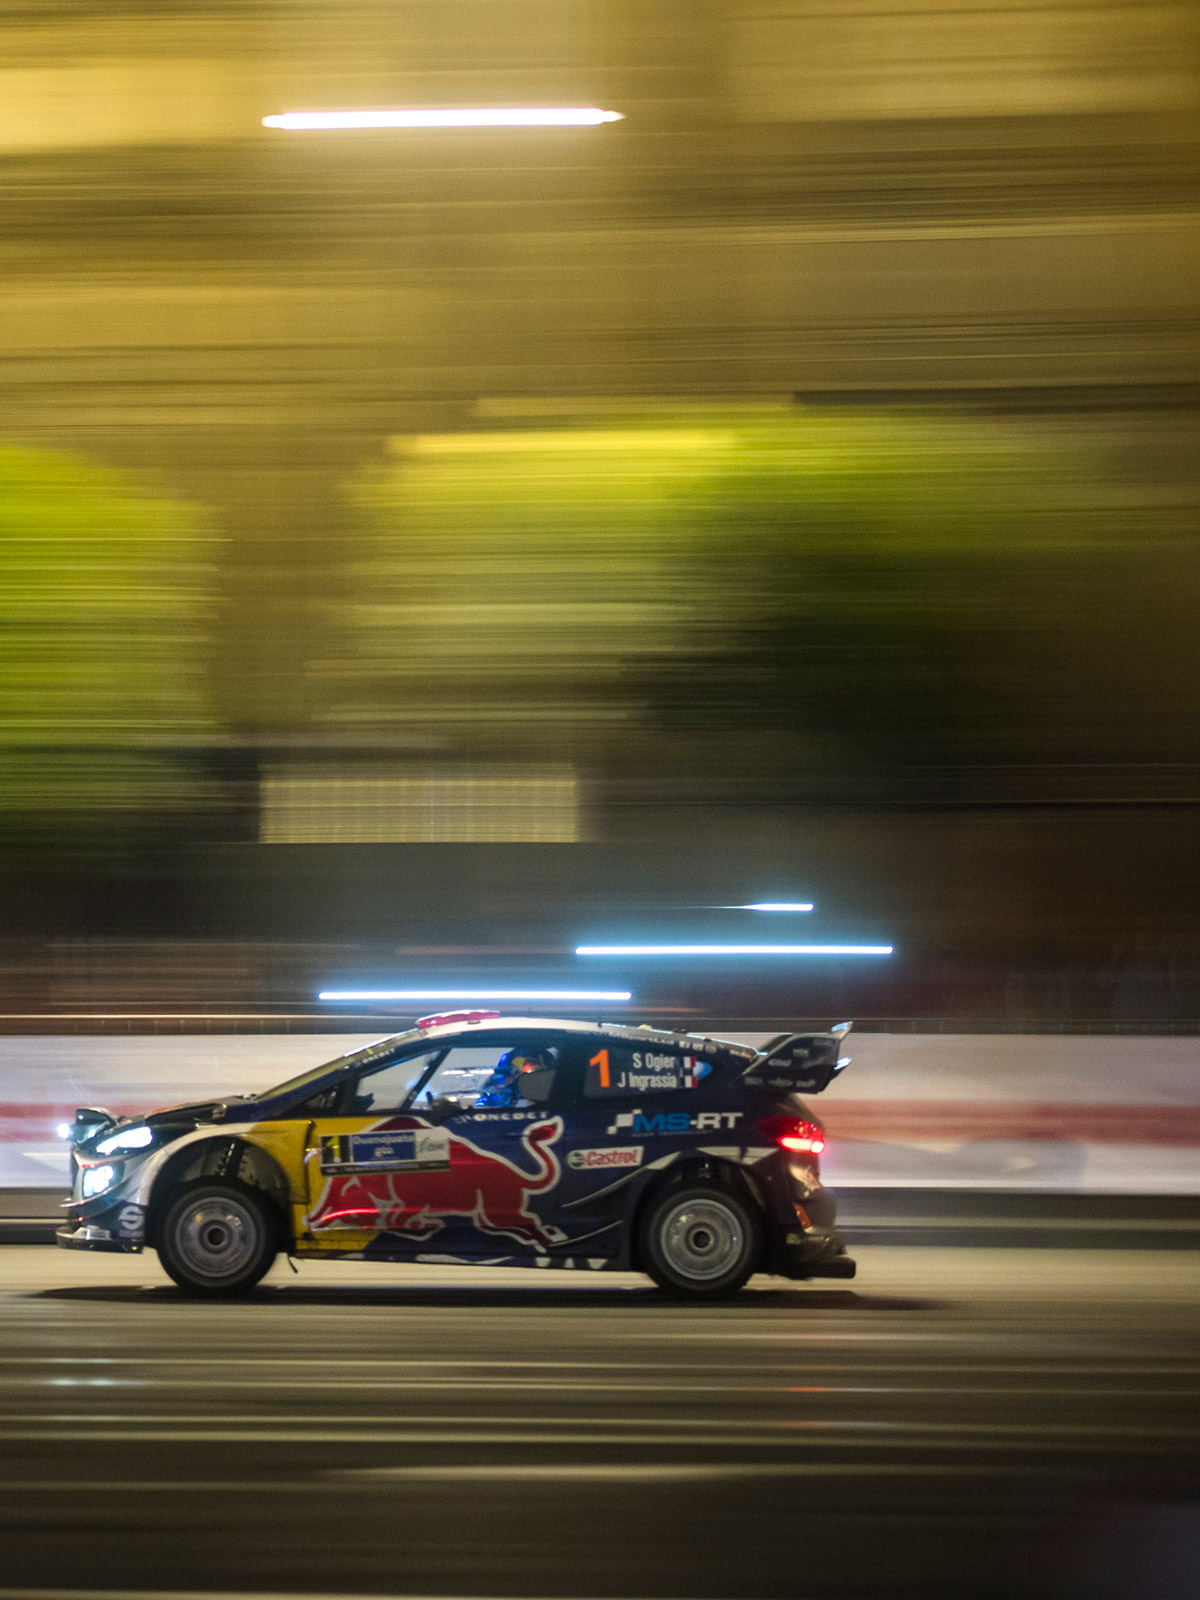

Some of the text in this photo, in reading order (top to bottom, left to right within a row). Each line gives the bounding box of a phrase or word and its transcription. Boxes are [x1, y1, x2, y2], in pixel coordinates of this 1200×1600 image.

[589, 1049, 610, 1087] 1
[632, 1053, 675, 1071] S Ogier
[618, 1072, 677, 1091] J Ingrassia
[633, 1113, 743, 1132] MS-RT
[327, 1136, 341, 1163] 1
[586, 1149, 638, 1166] Castrol
